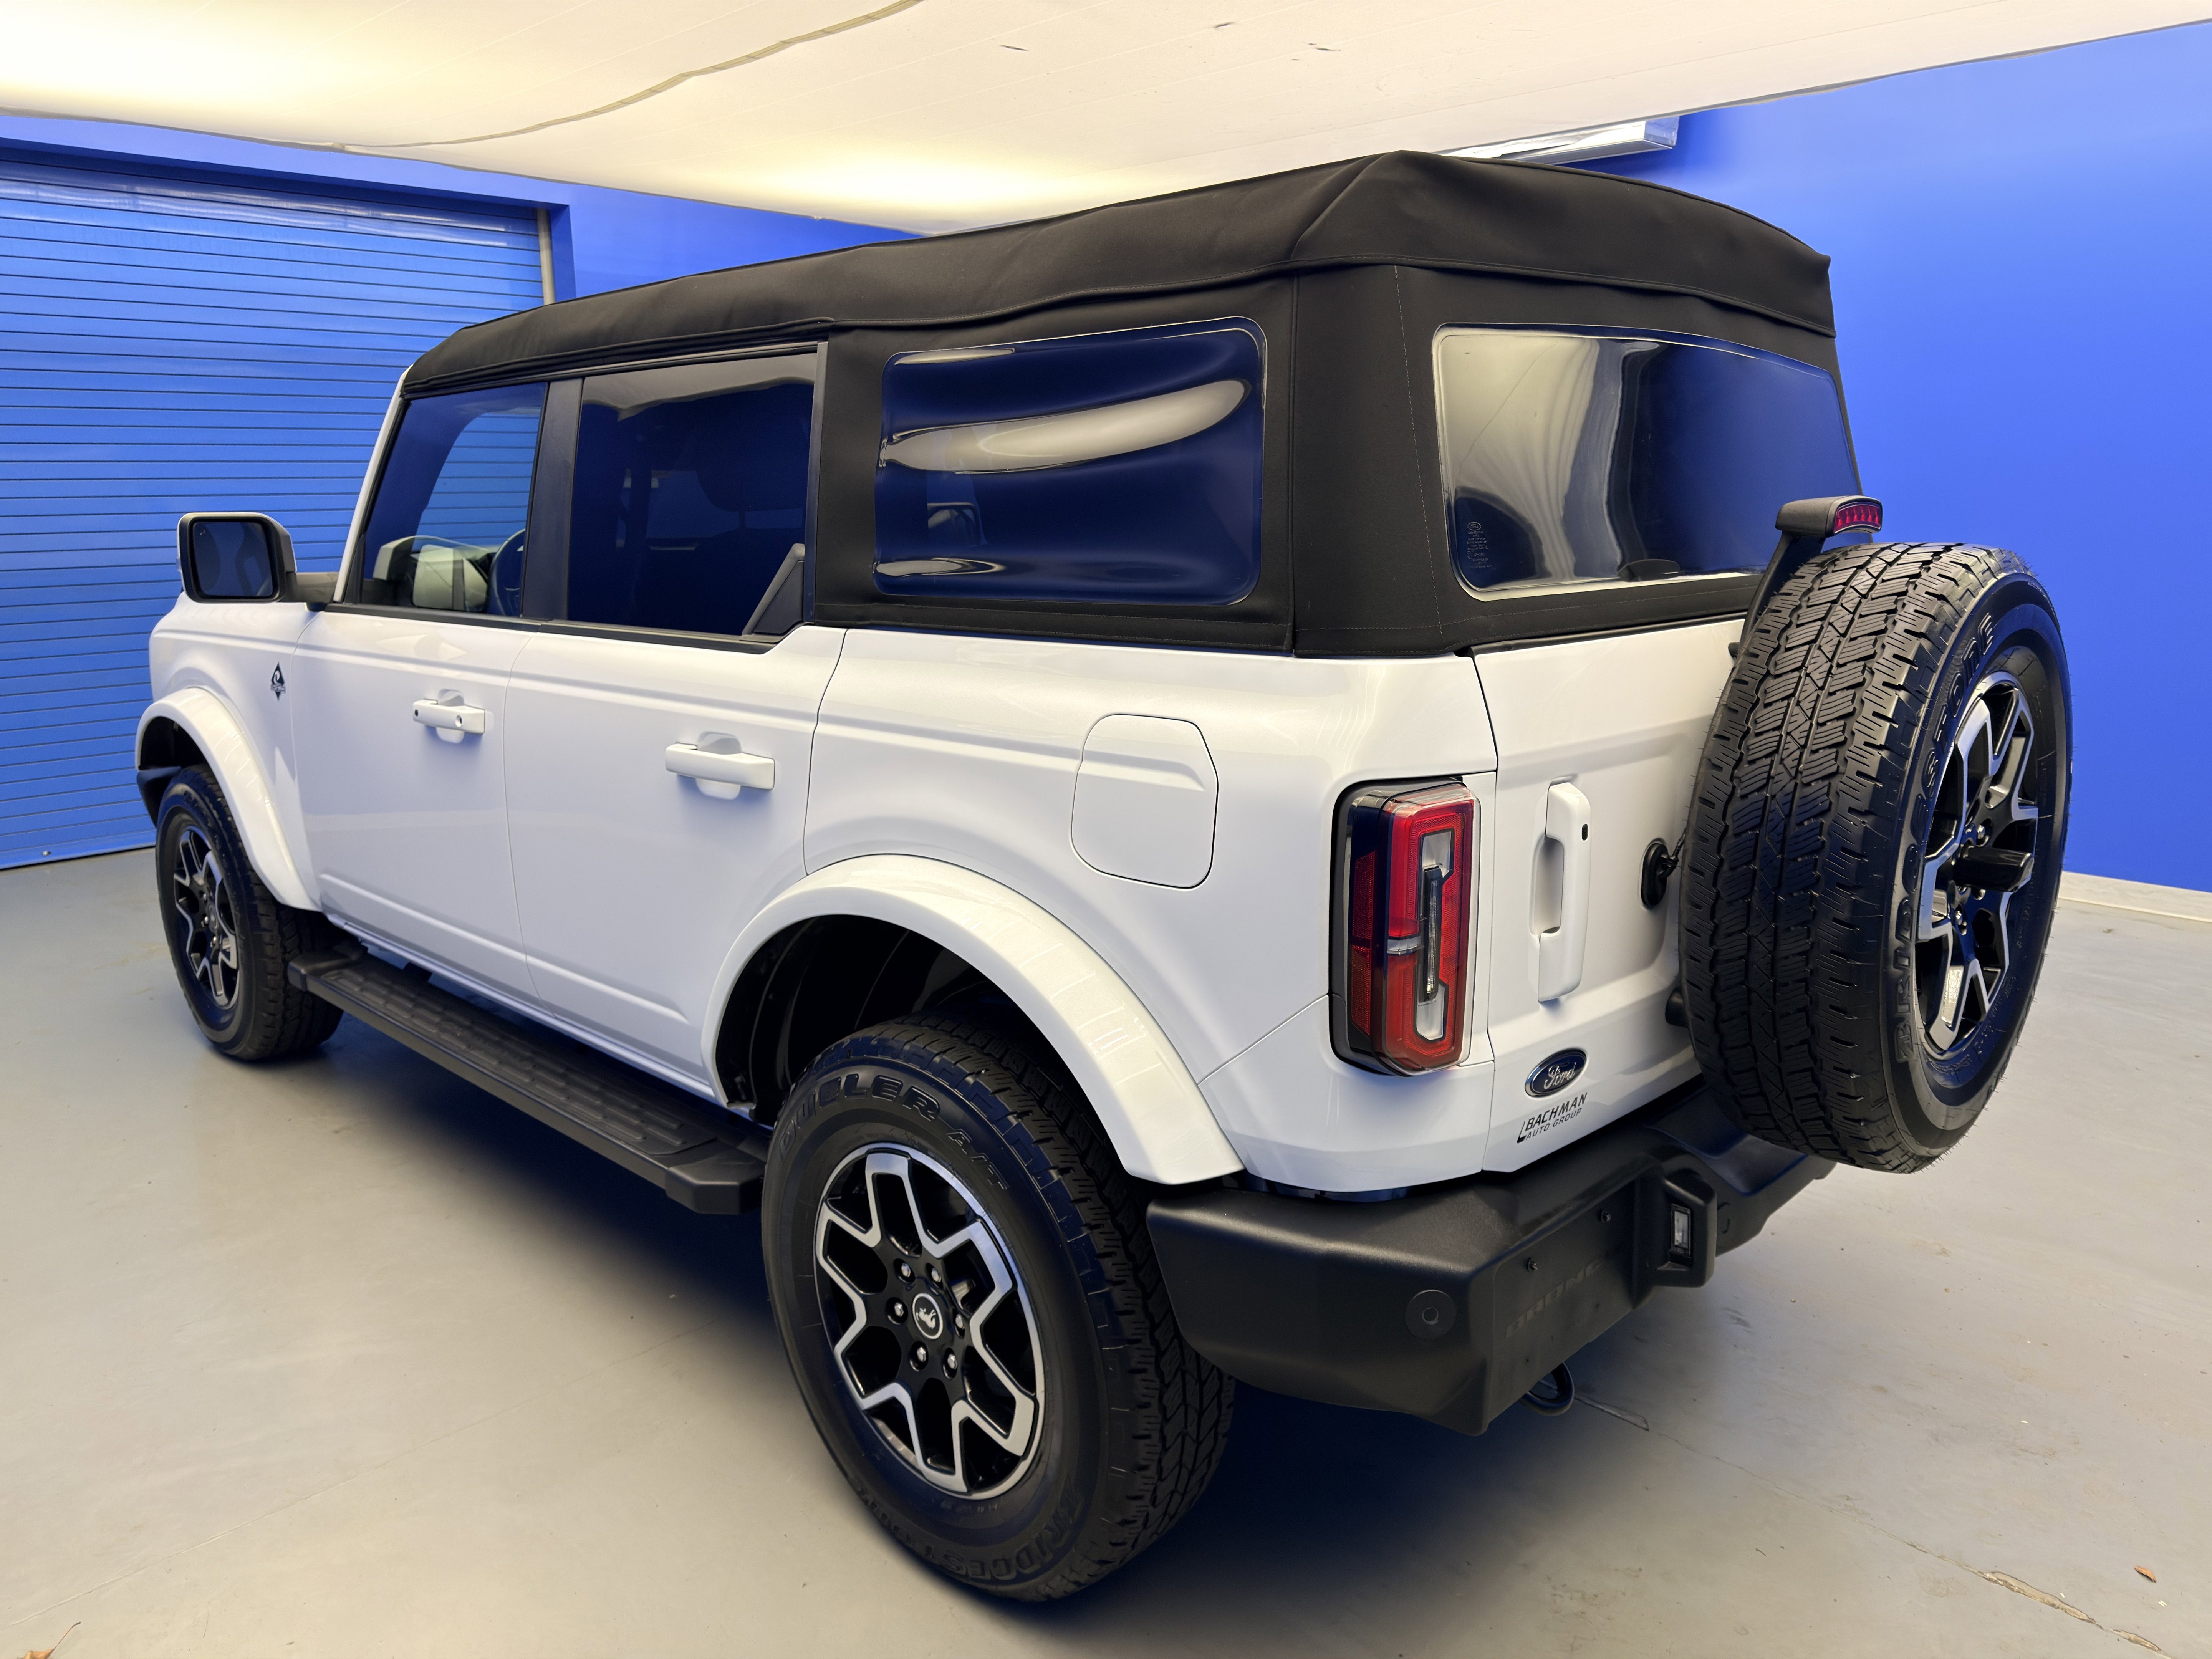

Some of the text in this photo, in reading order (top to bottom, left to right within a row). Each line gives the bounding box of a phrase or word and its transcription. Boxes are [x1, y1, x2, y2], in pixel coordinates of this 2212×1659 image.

[1544, 1060, 1576, 1090] Ford
[778, 1073, 1009, 1190] DUELER A/T
[1525, 1092, 1588, 1132] BACHMAN
[1525, 1108, 1583, 1141] AUTO GROUP
[1505, 1257, 1605, 1339] BRONC
